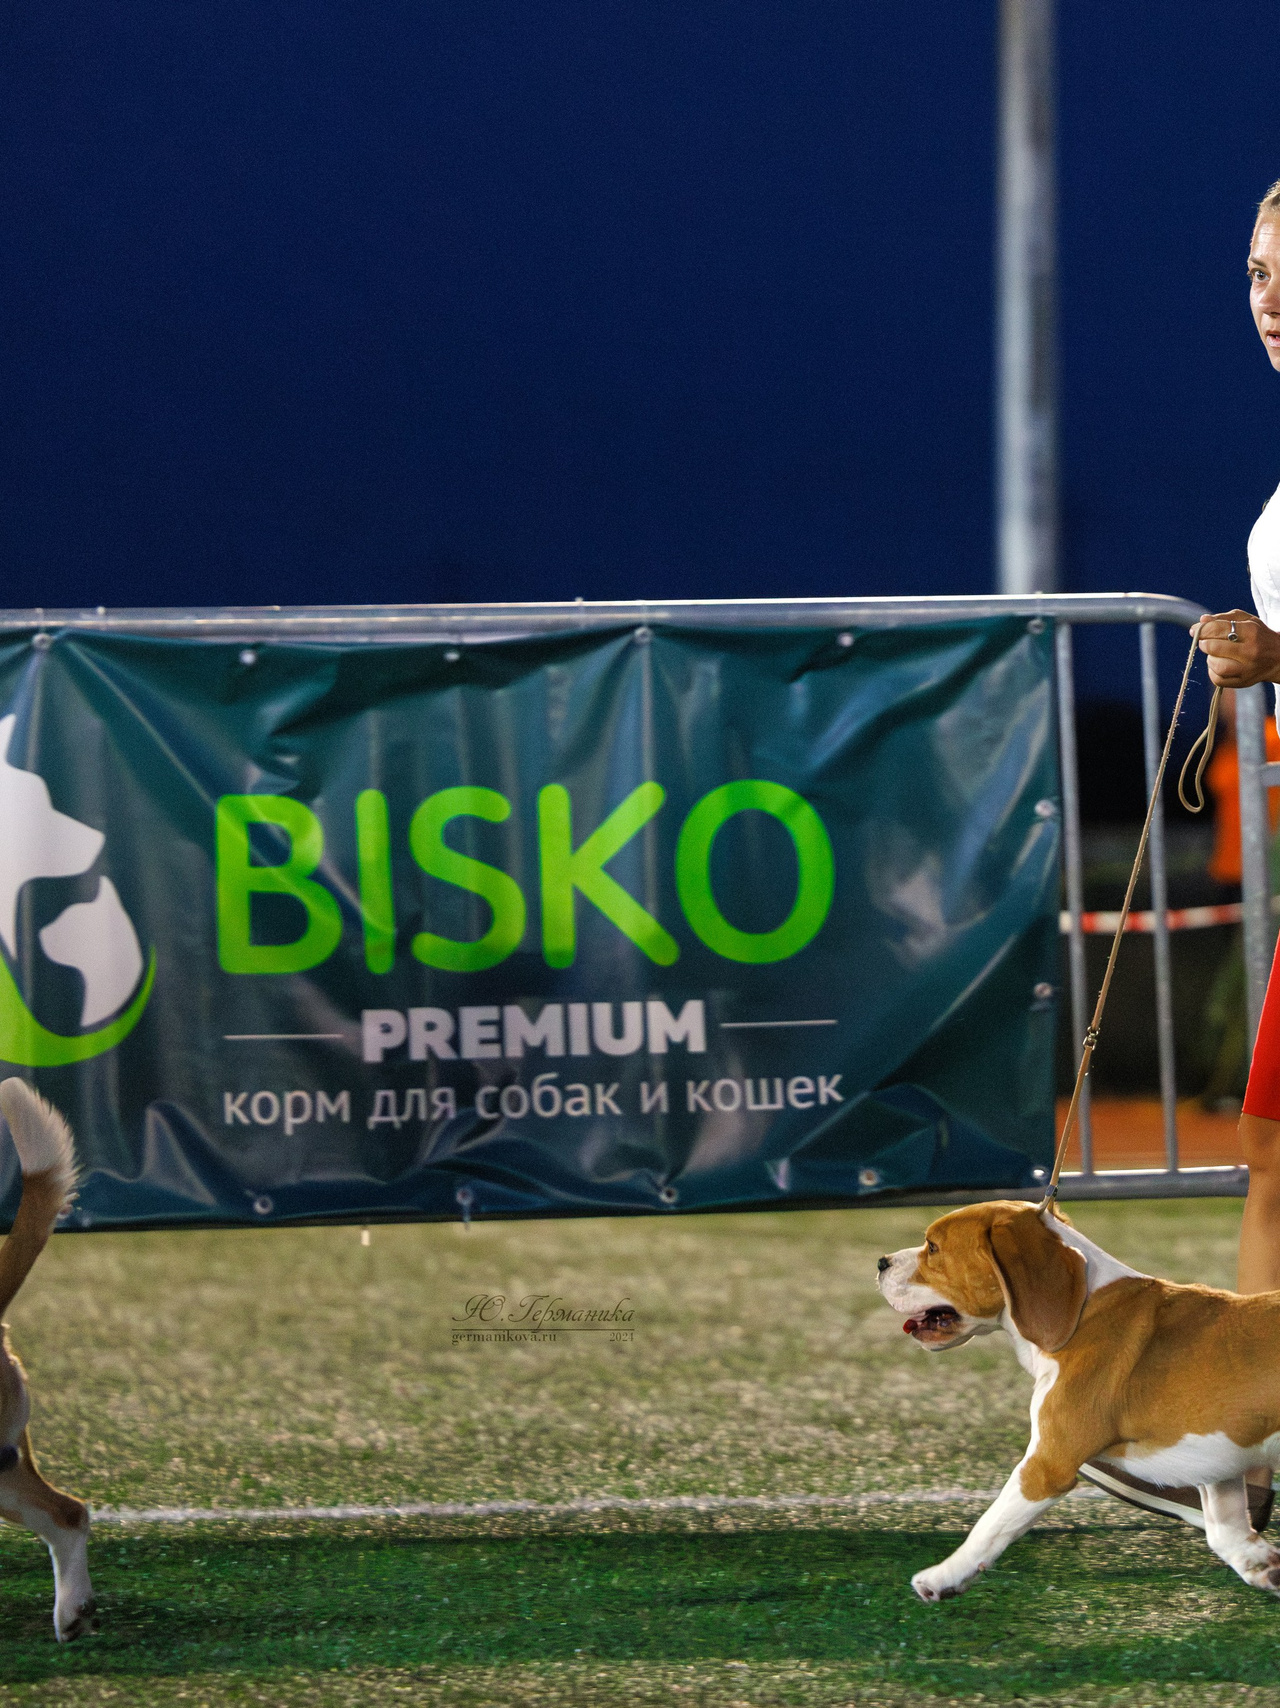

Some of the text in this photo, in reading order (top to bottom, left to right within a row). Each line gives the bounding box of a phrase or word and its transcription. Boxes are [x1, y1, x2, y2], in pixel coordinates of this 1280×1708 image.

[215, 778, 836, 975] BISKO
[362, 1000, 707, 1063] PREMIUM
[223, 1072, 844, 1135] корм для собак и кошек
